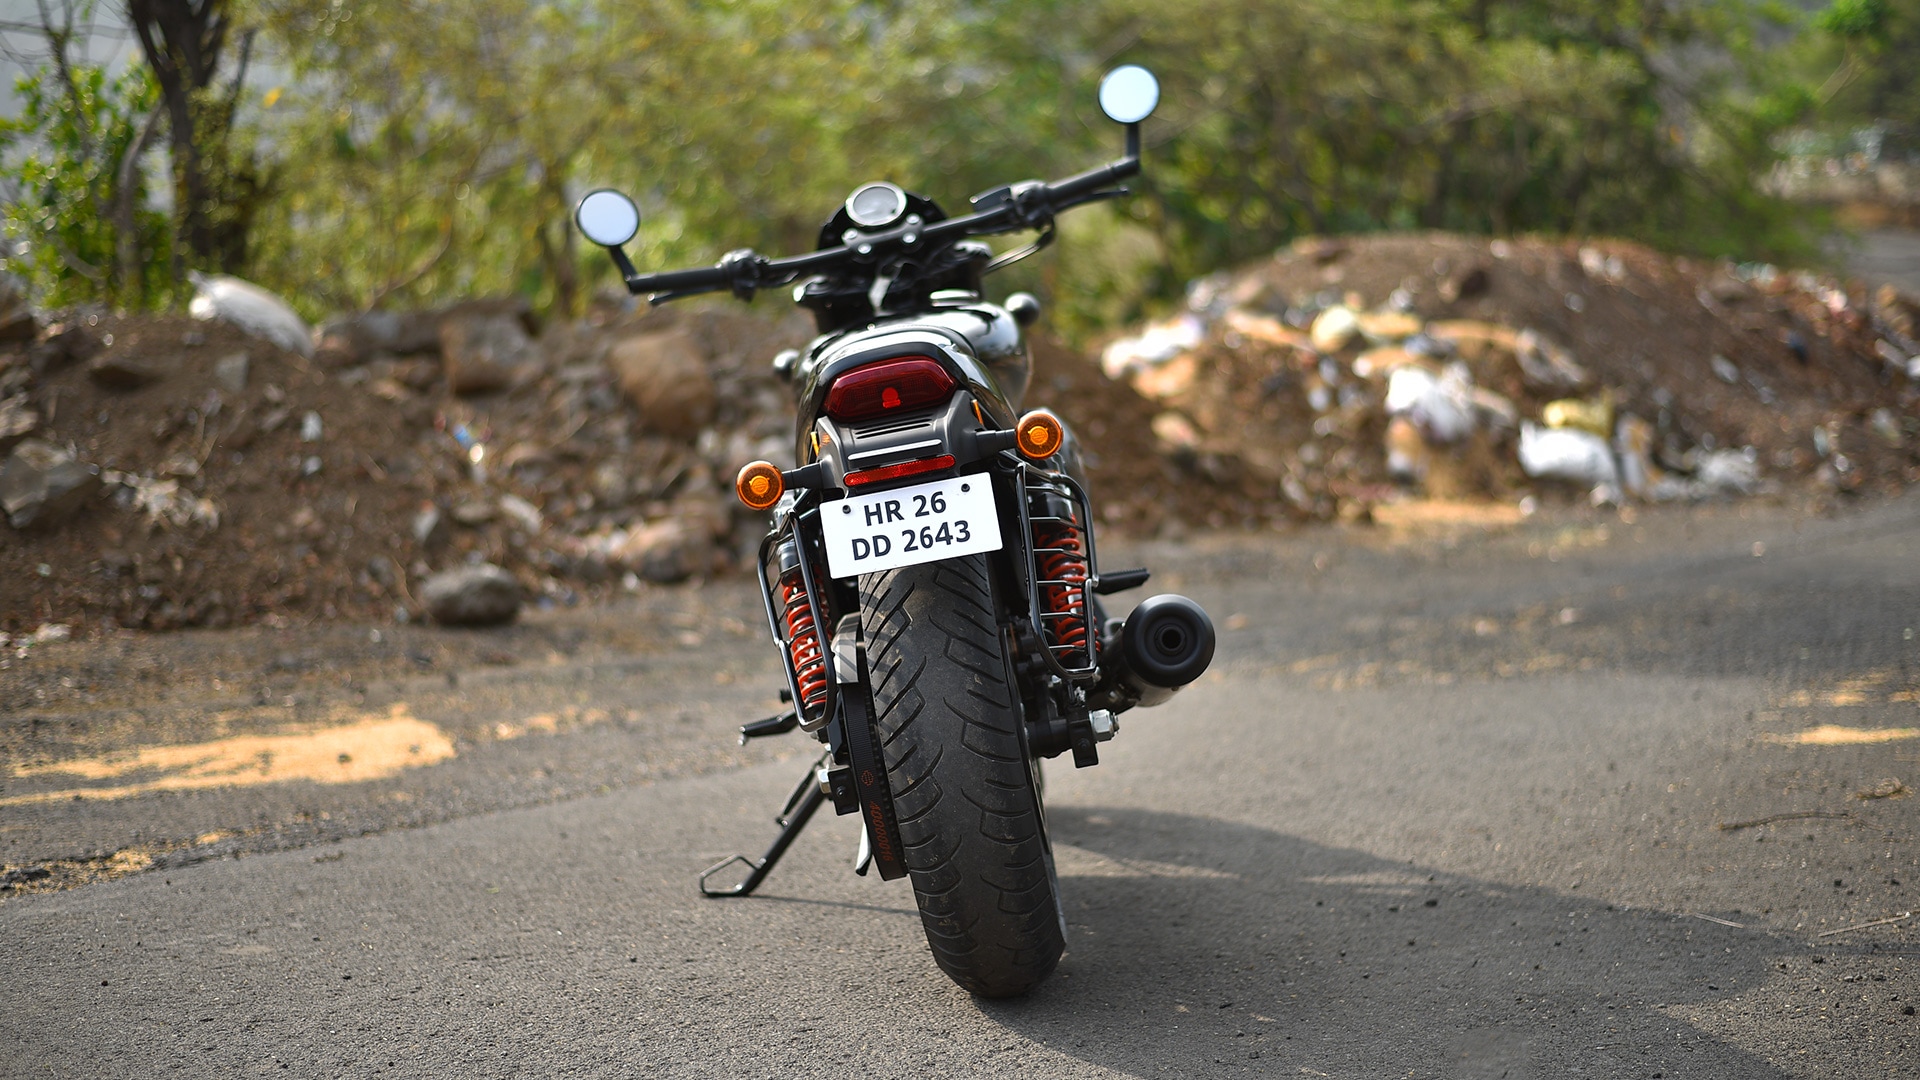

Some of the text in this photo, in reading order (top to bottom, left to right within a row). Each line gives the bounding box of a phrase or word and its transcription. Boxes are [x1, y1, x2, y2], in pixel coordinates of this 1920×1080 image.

[863, 490, 947, 527] HR 26
[851, 520, 971, 561] DD 2643
